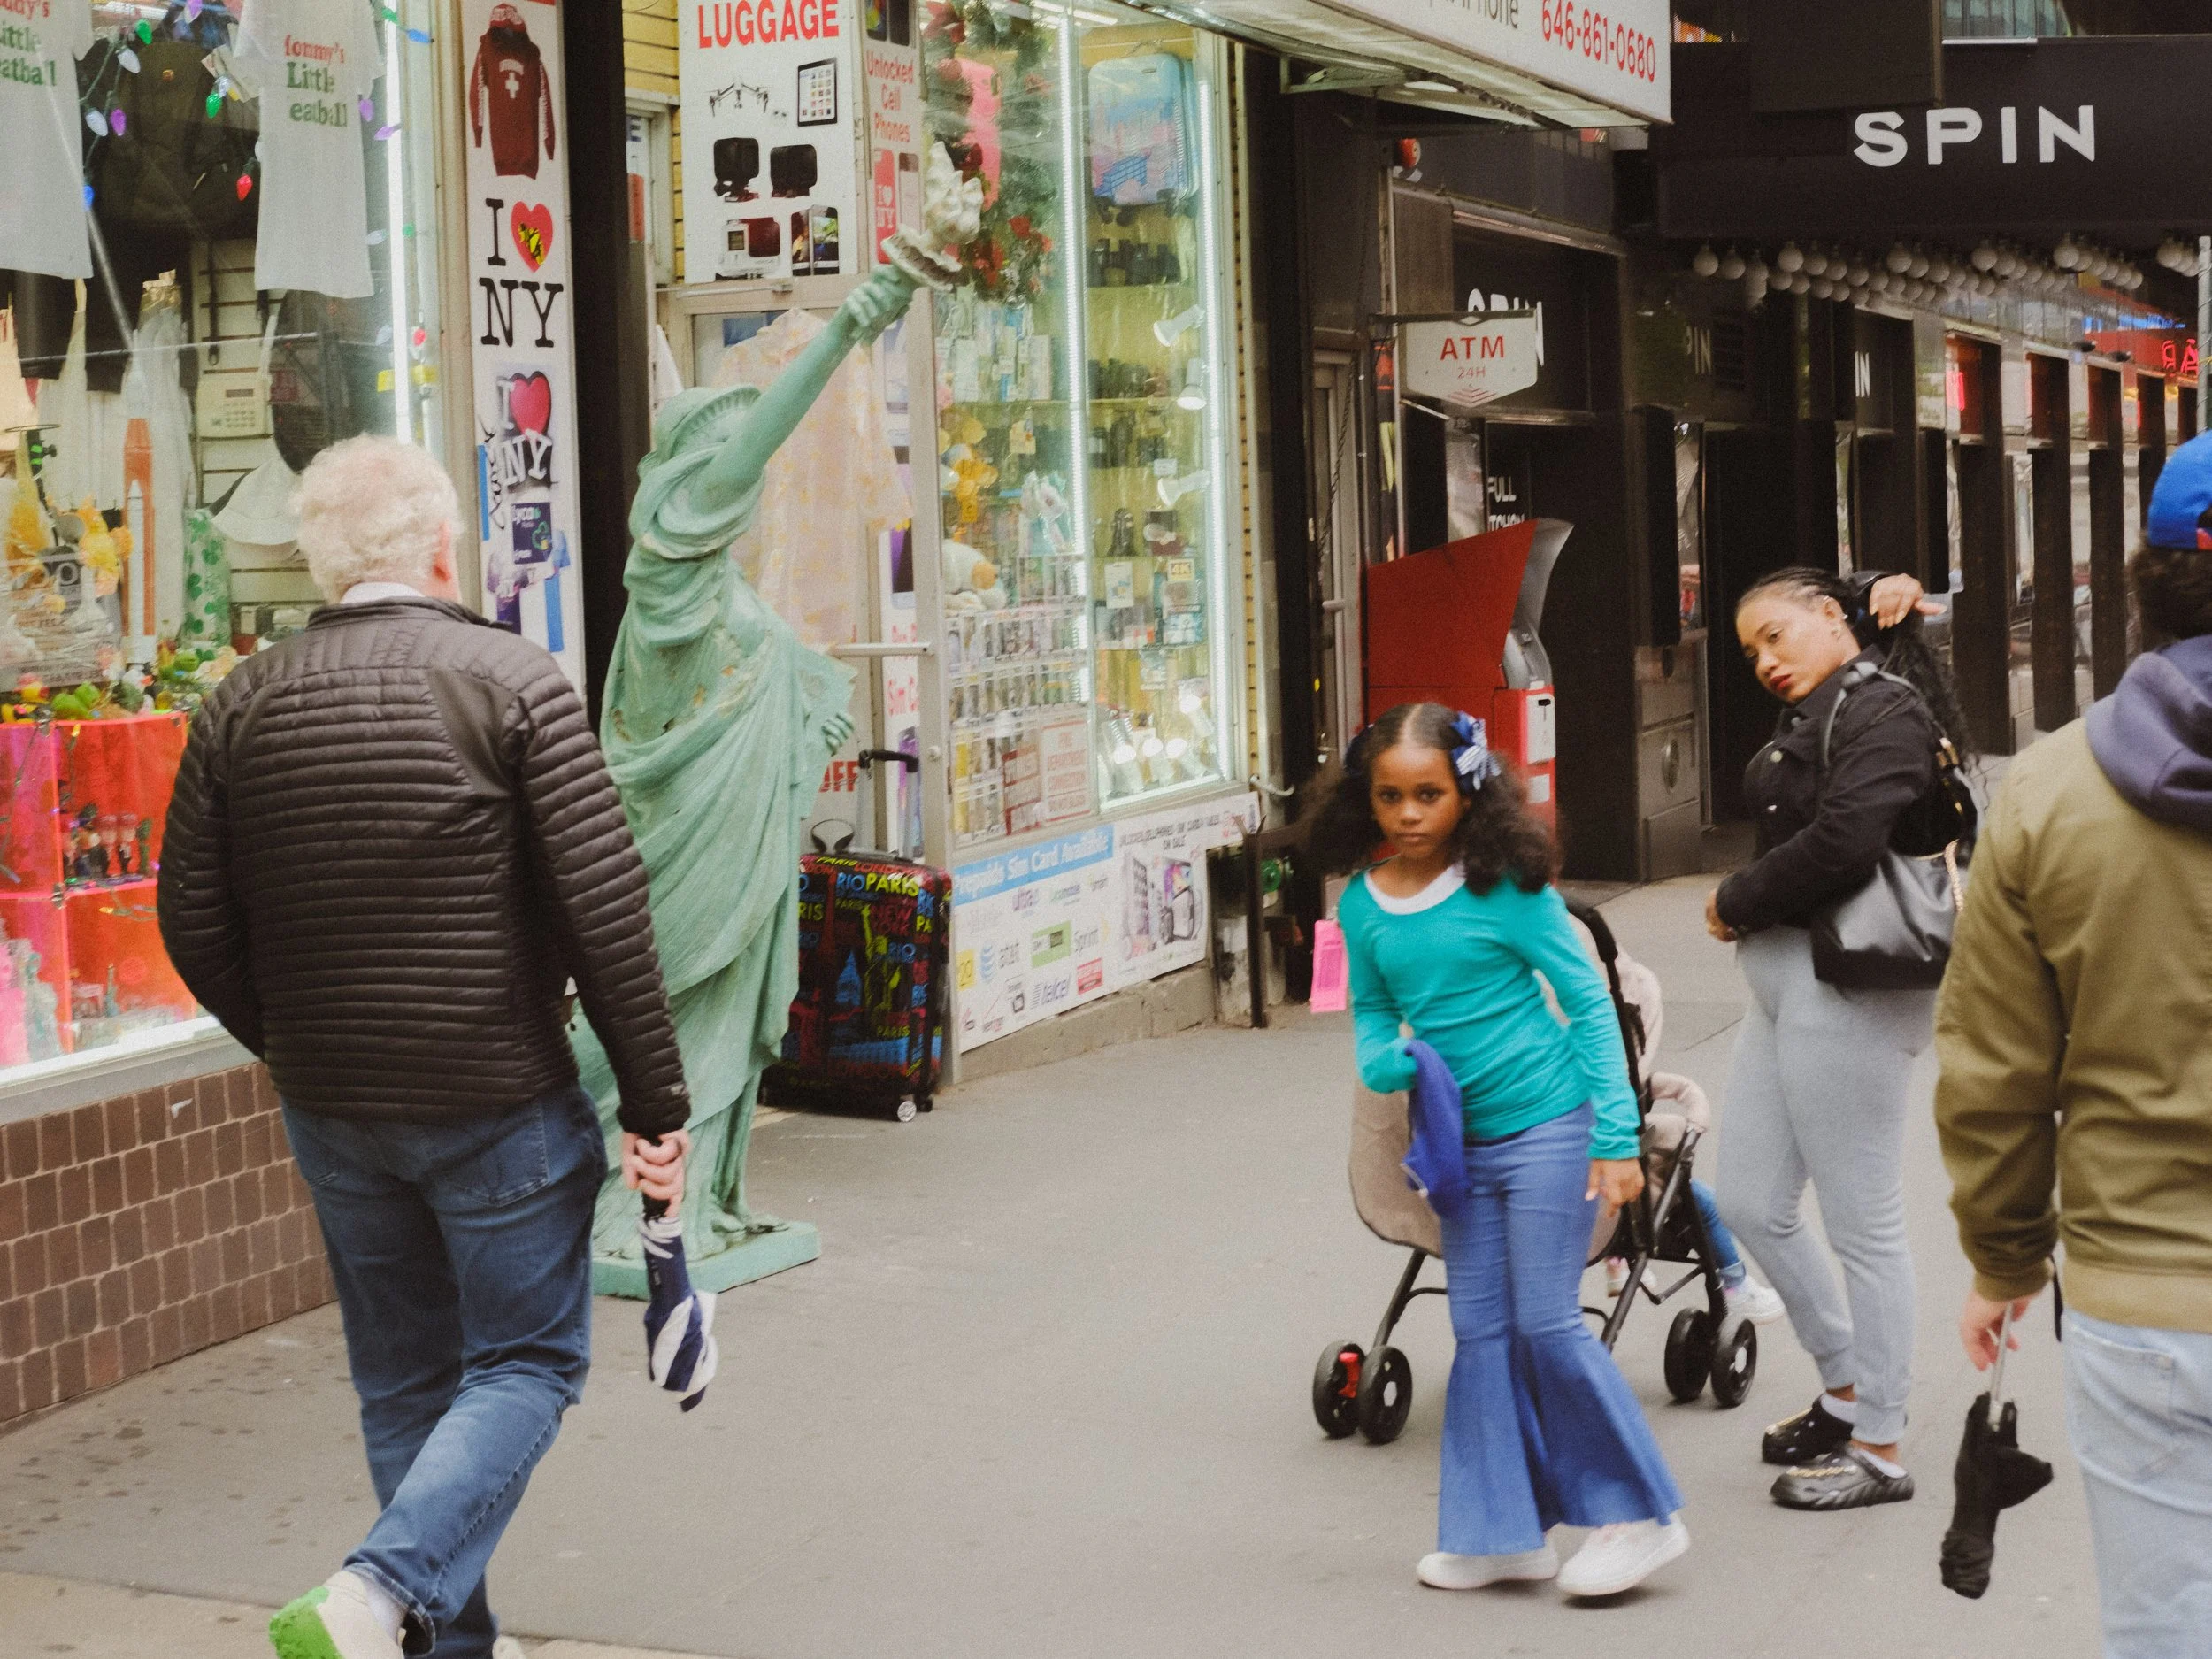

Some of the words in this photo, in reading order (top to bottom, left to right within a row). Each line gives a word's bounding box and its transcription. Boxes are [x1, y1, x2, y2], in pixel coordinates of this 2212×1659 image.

[698, 0, 840, 49] LUGGAGE
[1541, 0, 1656, 83] 646-861-0680
[865, 49, 915, 85] Unlocked
[880, 84, 902, 112] Cell
[873, 112, 911, 143] Phones
[1853, 104, 2096, 168] SPIN
[485, 197, 507, 267] I
[479, 278, 564, 348] NY
[1440, 335, 1506, 361] ATM
[1457, 366, 1486, 380] 24H
[501, 430, 554, 485] NY
[1487, 476, 1517, 503] FULL
[1031, 843, 1059, 872] Card
[836, 872, 865, 892] RIO
[865, 872, 919, 897] PARIS
[798, 902, 825, 921] RIS
